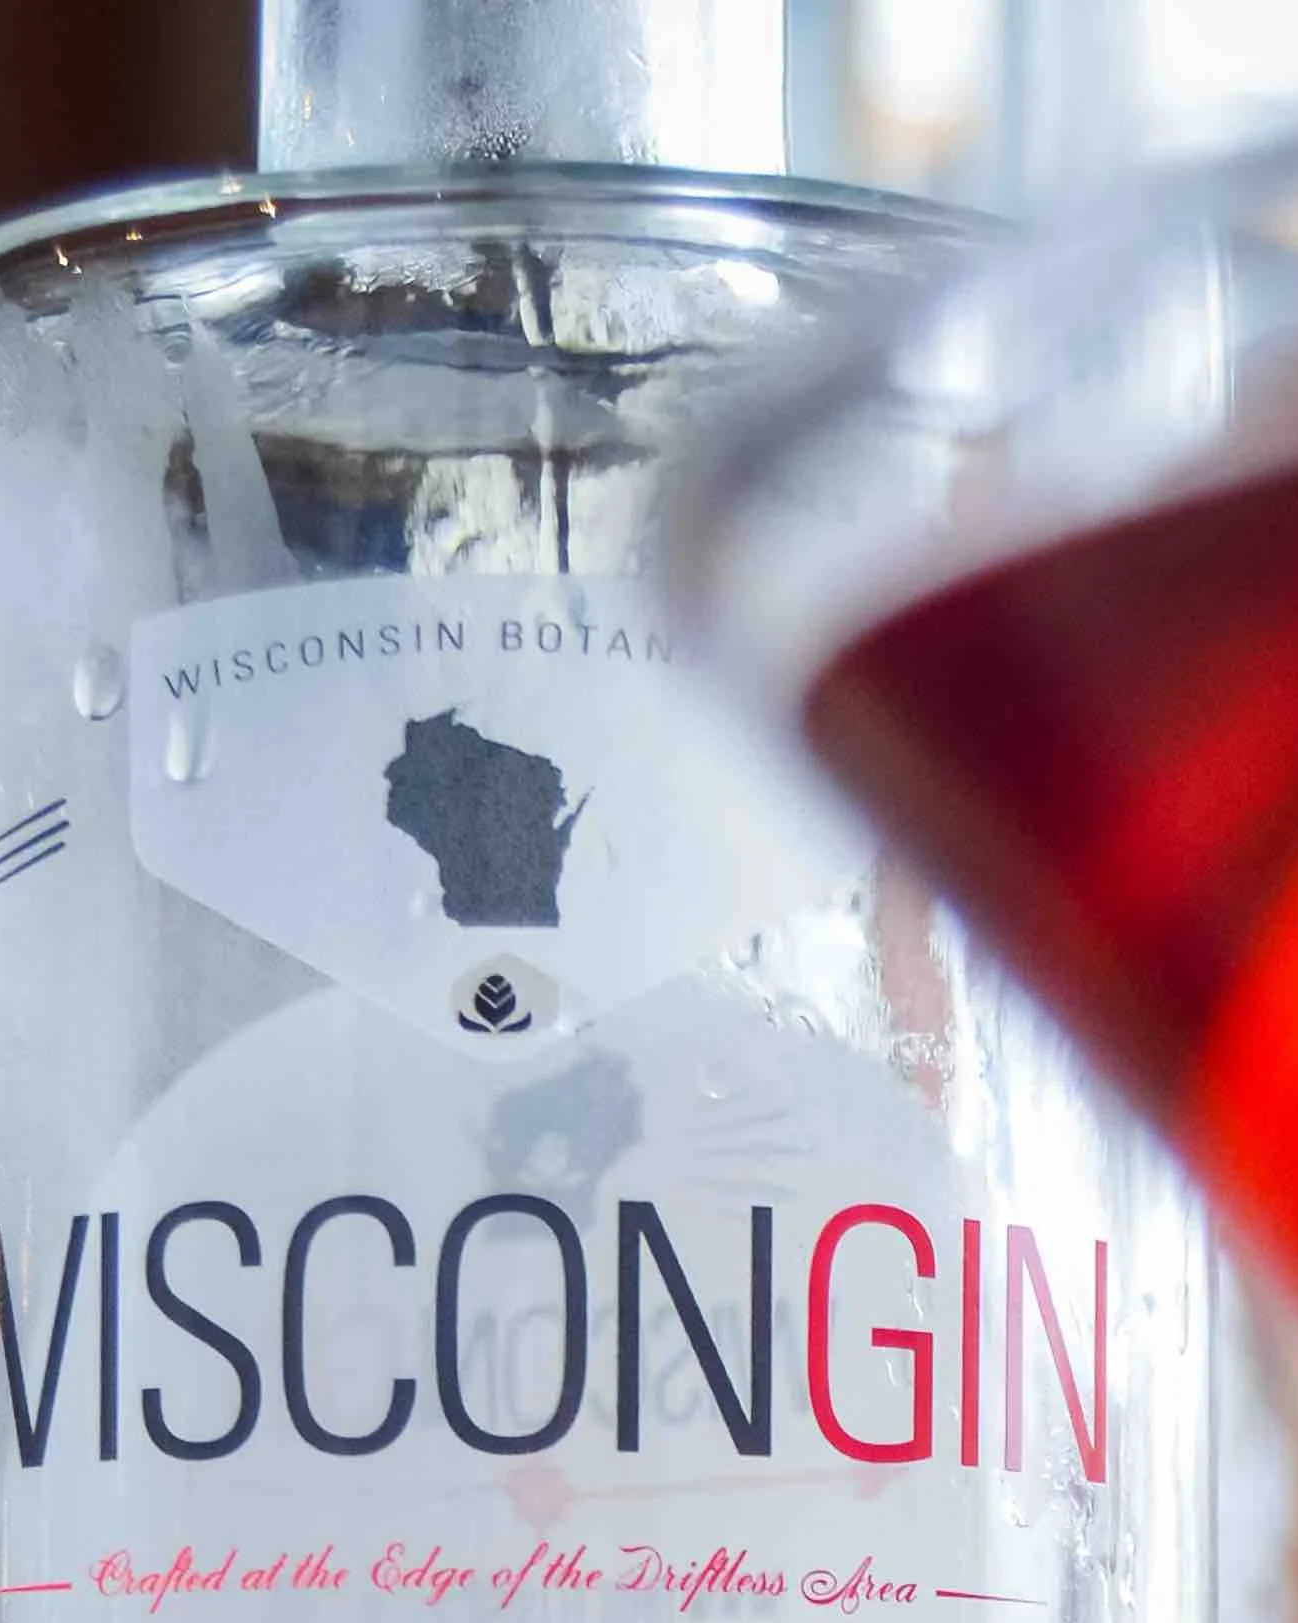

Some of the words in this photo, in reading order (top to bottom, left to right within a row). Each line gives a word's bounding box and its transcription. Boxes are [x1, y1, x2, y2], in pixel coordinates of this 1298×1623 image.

[163, 619, 465, 700] WISCONSIN
[500, 619, 674, 665] BOTAN
[88, 1544, 239, 1615] Crafted
[240, 1551, 290, 1592] at
[290, 1543, 350, 1592] the
[370, 1541, 476, 1607] Edge
[491, 1540, 550, 1610] of
[542, 1543, 604, 1590] the
[614, 1544, 788, 1613] Driftless
[800, 1555, 918, 1616] Area
